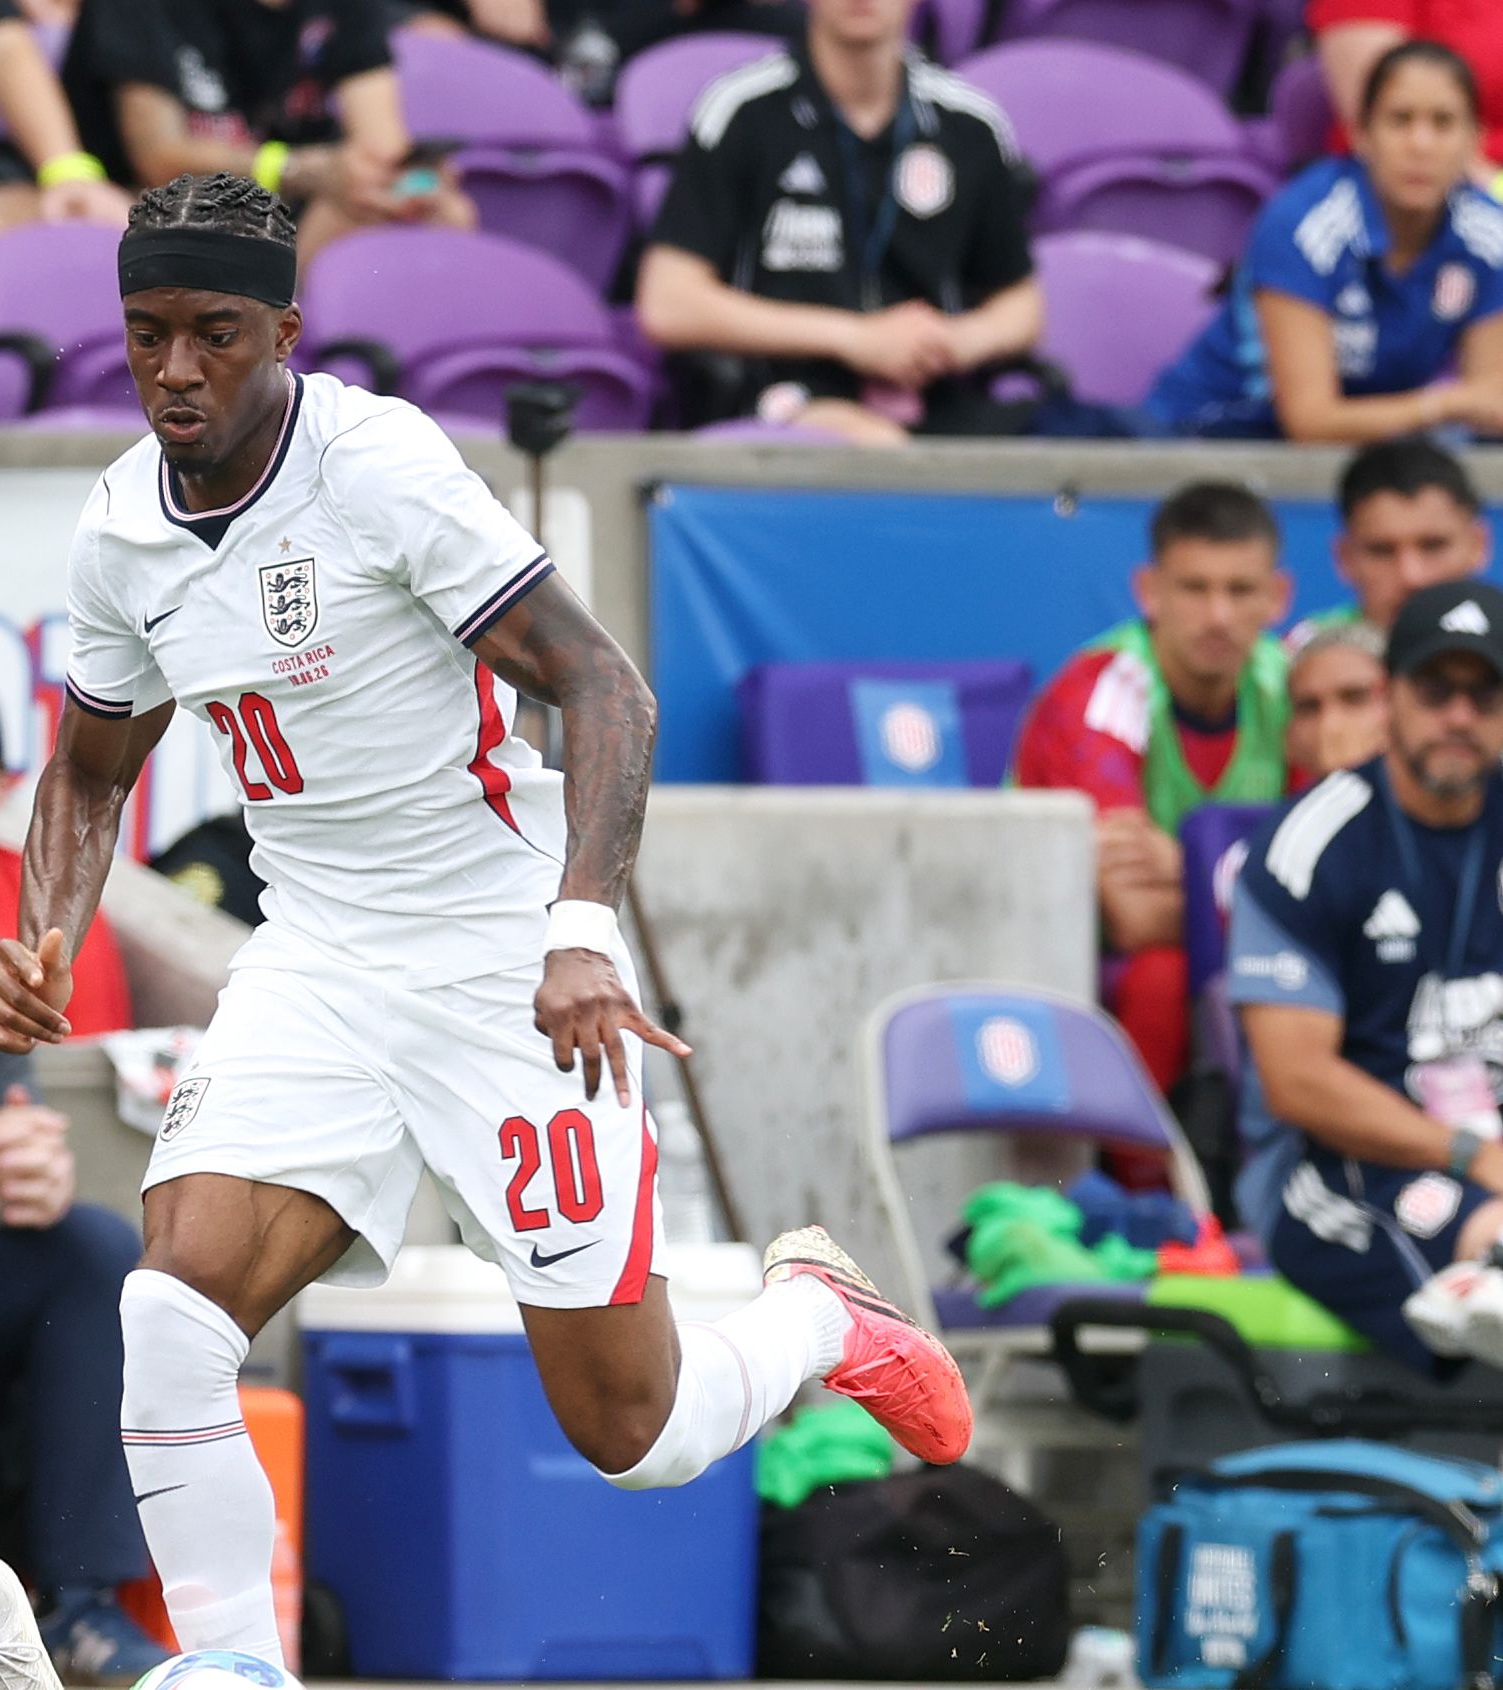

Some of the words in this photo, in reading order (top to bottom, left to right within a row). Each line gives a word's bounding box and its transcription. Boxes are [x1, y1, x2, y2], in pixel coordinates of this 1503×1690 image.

[271, 655, 306, 674] COSTA
[305, 644, 336, 665] RICA
[204, 691, 304, 801] 20
[497, 1108, 605, 1233] 20
